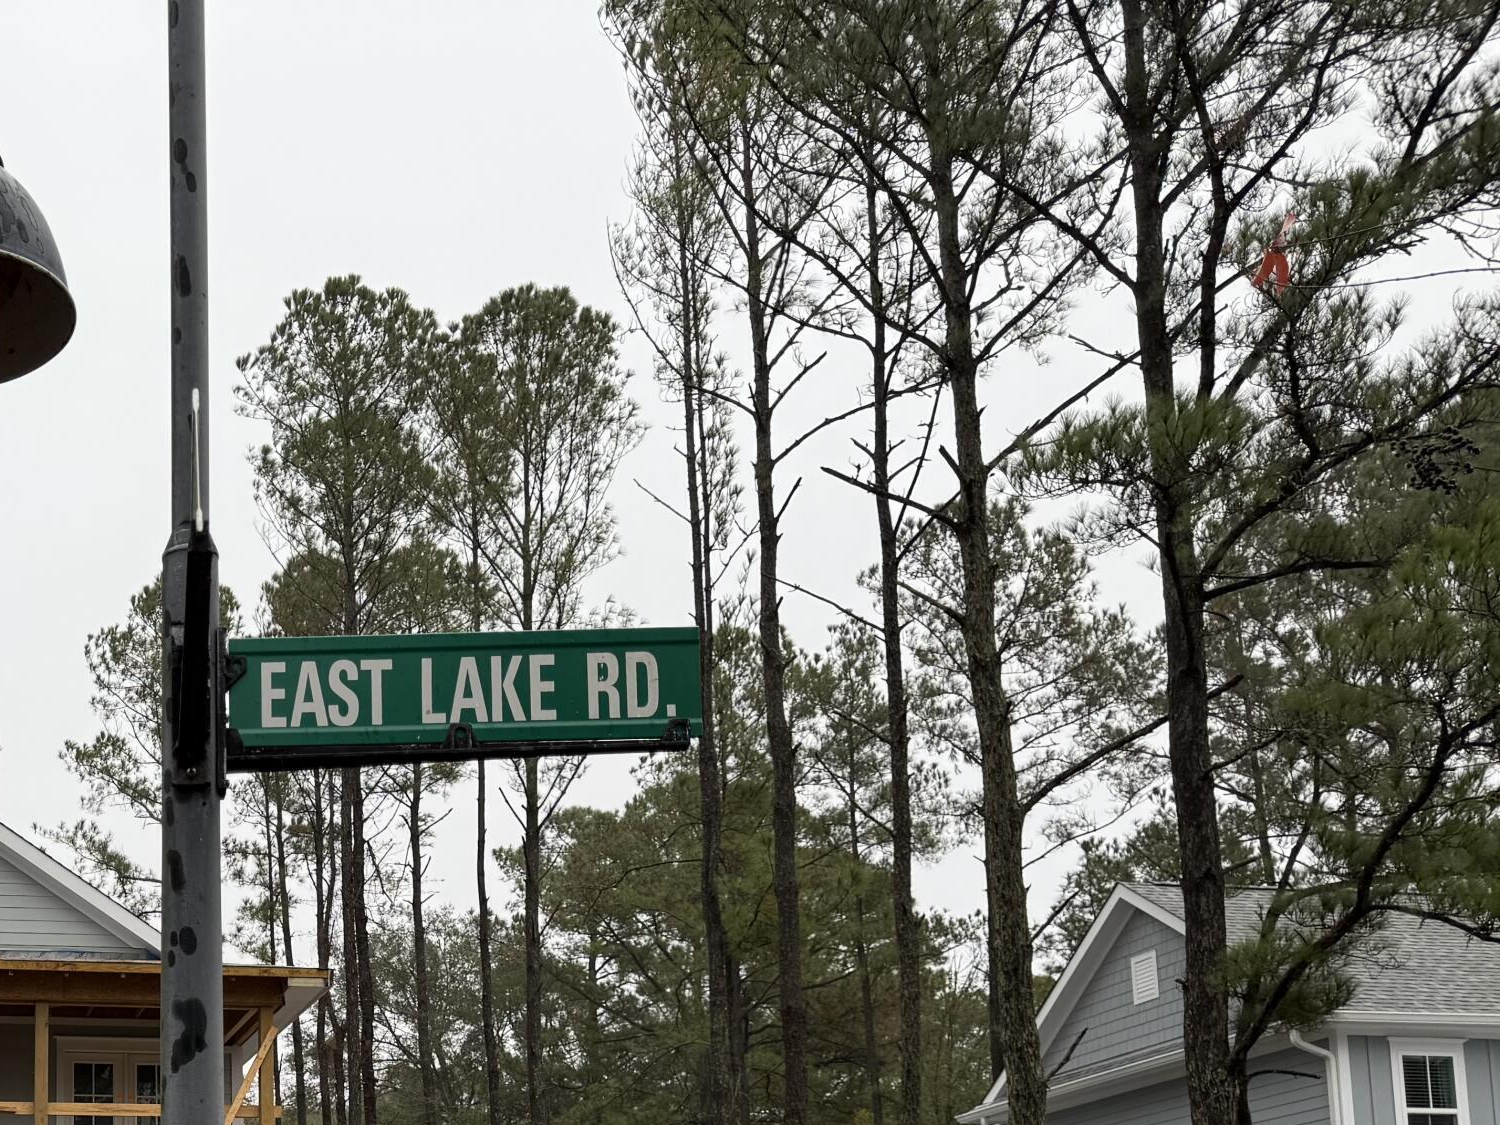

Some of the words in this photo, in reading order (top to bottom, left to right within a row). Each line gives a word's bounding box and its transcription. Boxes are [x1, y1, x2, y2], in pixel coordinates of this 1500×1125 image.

[260, 660, 393, 728] EAST
[421, 654, 557, 724] LAKE
[586, 651, 676, 720] RD.
